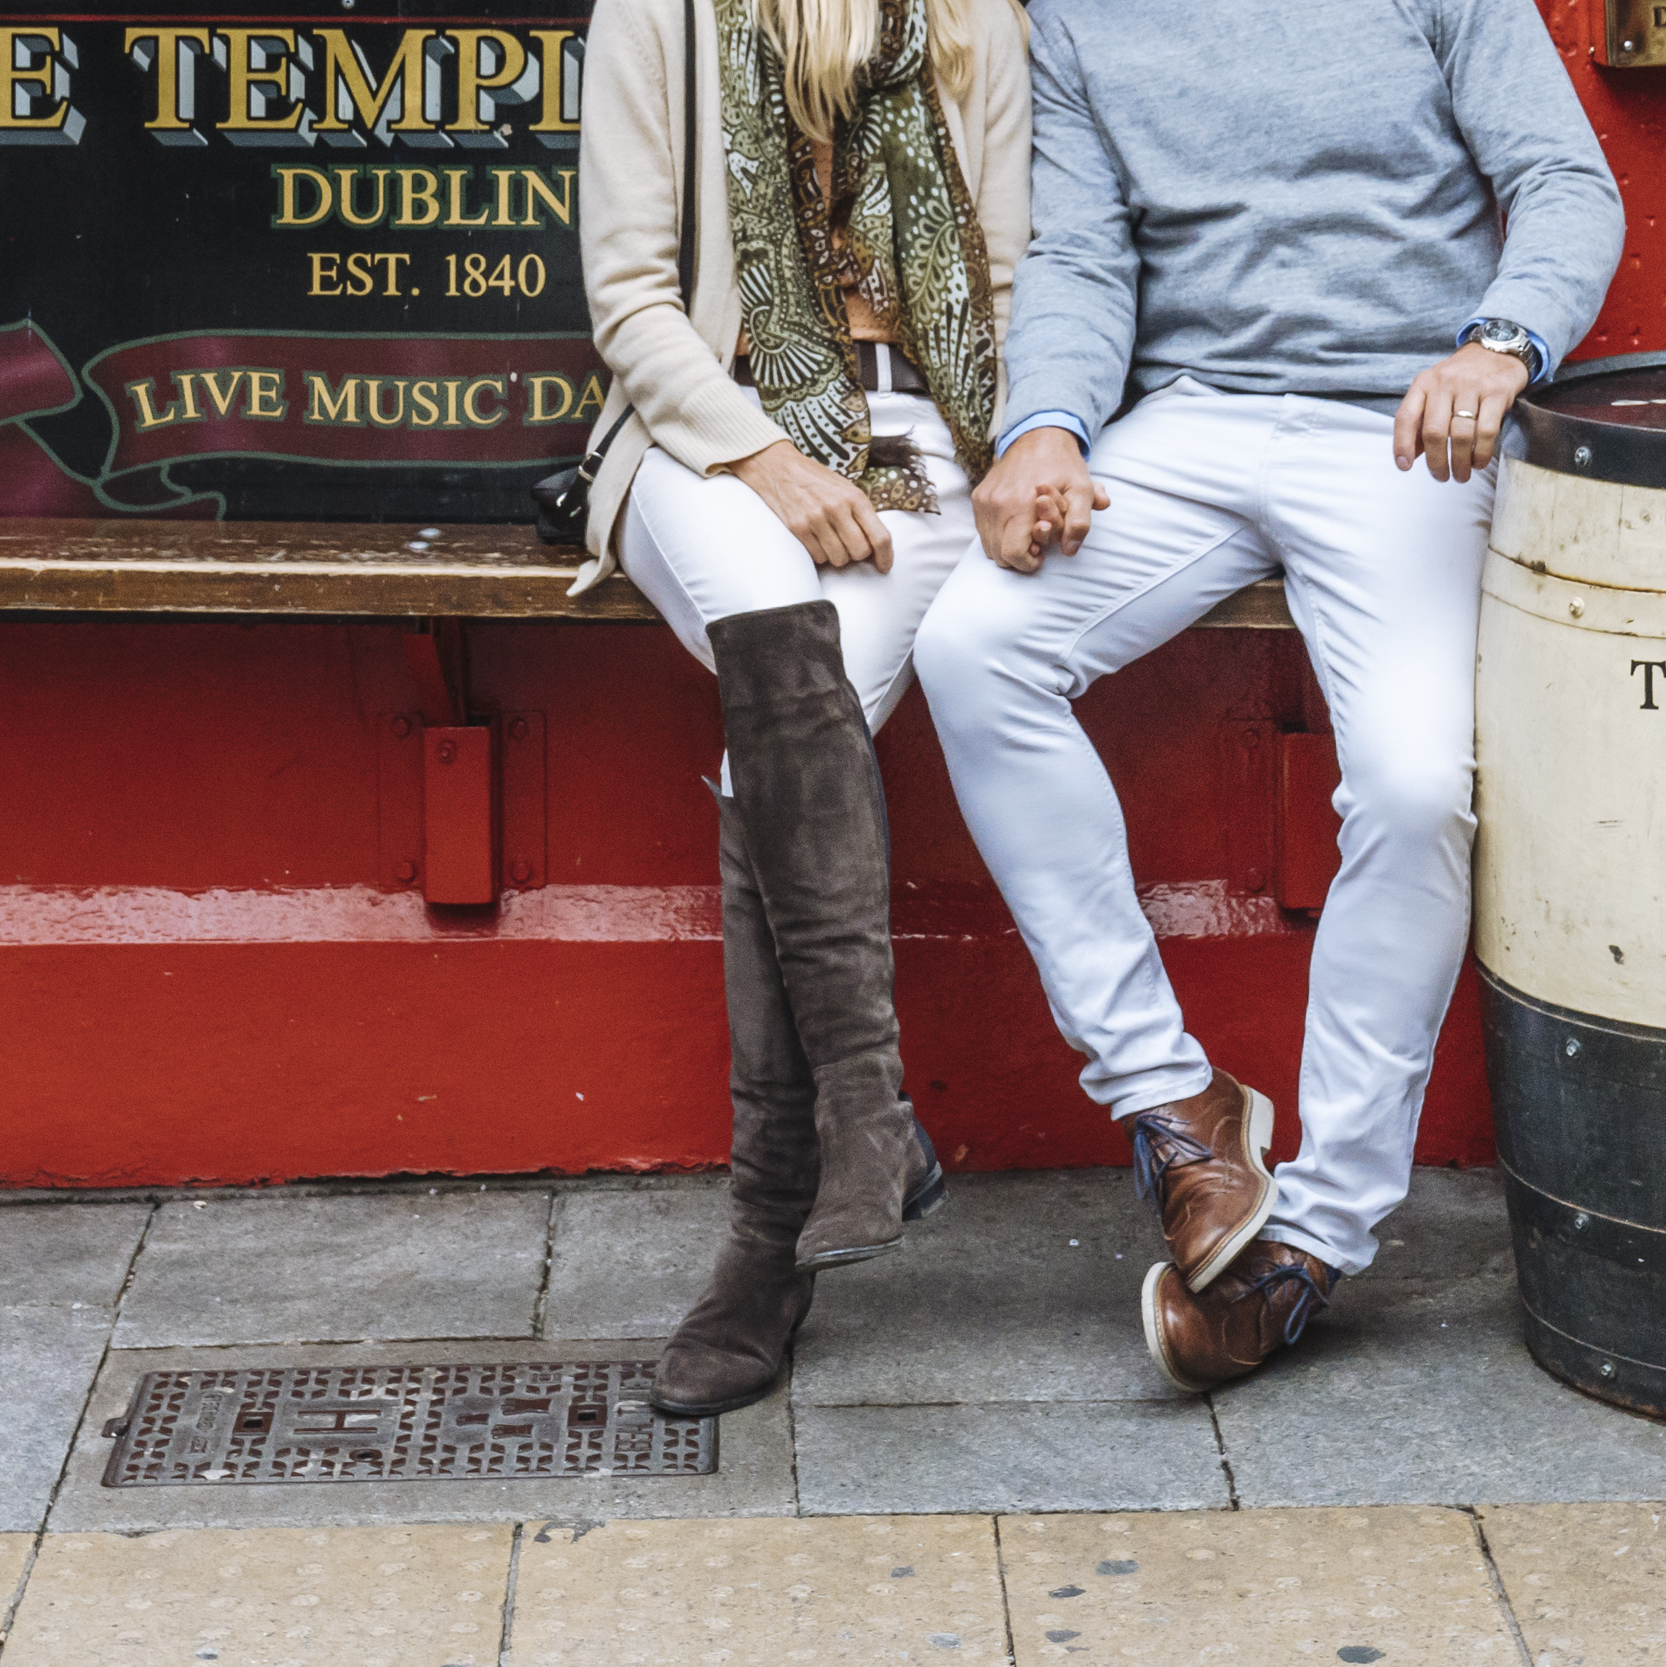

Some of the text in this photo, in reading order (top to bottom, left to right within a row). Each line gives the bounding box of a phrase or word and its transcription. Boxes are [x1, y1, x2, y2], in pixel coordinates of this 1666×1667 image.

[275, 167, 578, 228] DUBLIN
[306, 253, 547, 299] EST. 1840
[131, 371, 283, 427] LIVE
[309, 375, 505, 427] MUSIC
